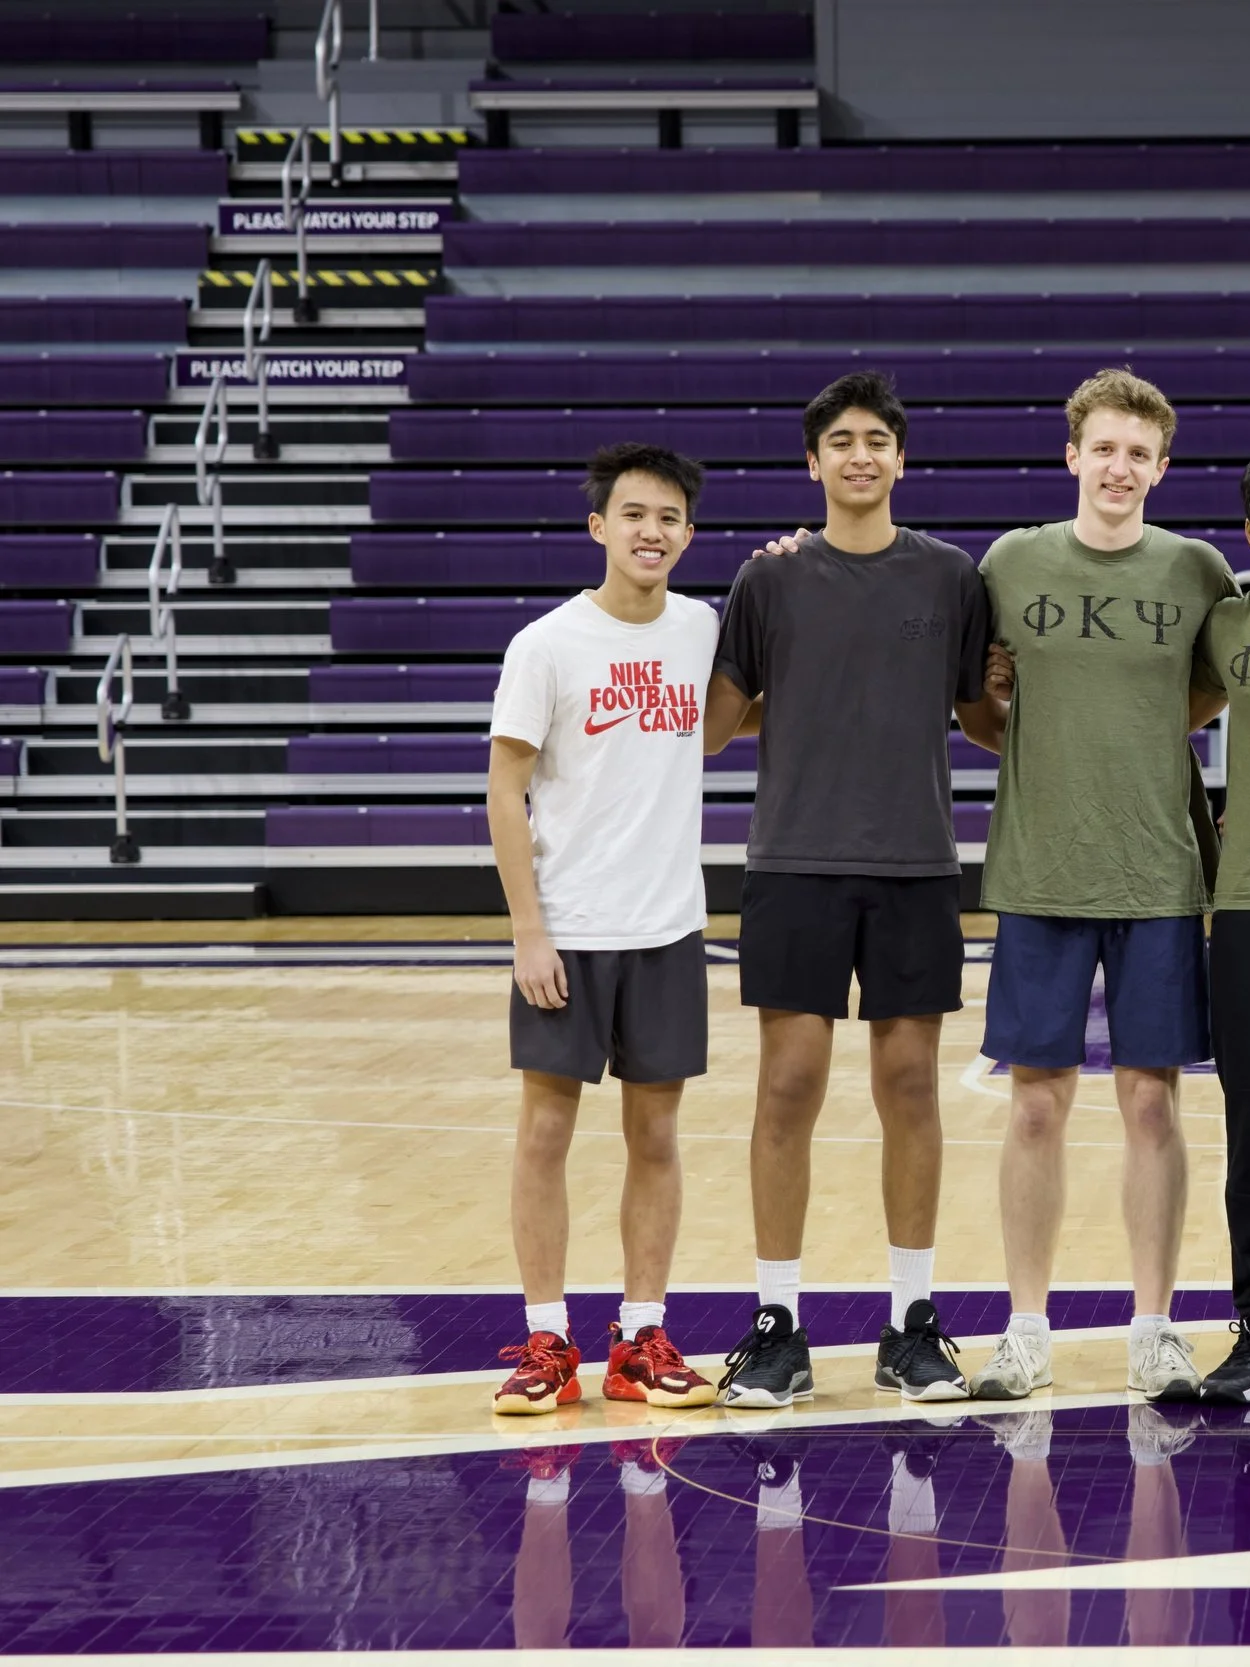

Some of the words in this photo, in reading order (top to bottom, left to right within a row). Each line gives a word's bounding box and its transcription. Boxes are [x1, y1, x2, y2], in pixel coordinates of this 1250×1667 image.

[232, 211, 288, 231] PLEAS
[303, 211, 350, 230] ATCH
[351, 211, 396, 230] YOUR
[397, 210, 440, 230] STEP
[264, 360, 312, 378] ATCH
[313, 360, 360, 378] YOUR
[361, 359, 405, 378] STEP
[609, 660, 663, 687] NIKE
[589, 683, 698, 713] FOOTBALL
[638, 707, 699, 732] CAMP
